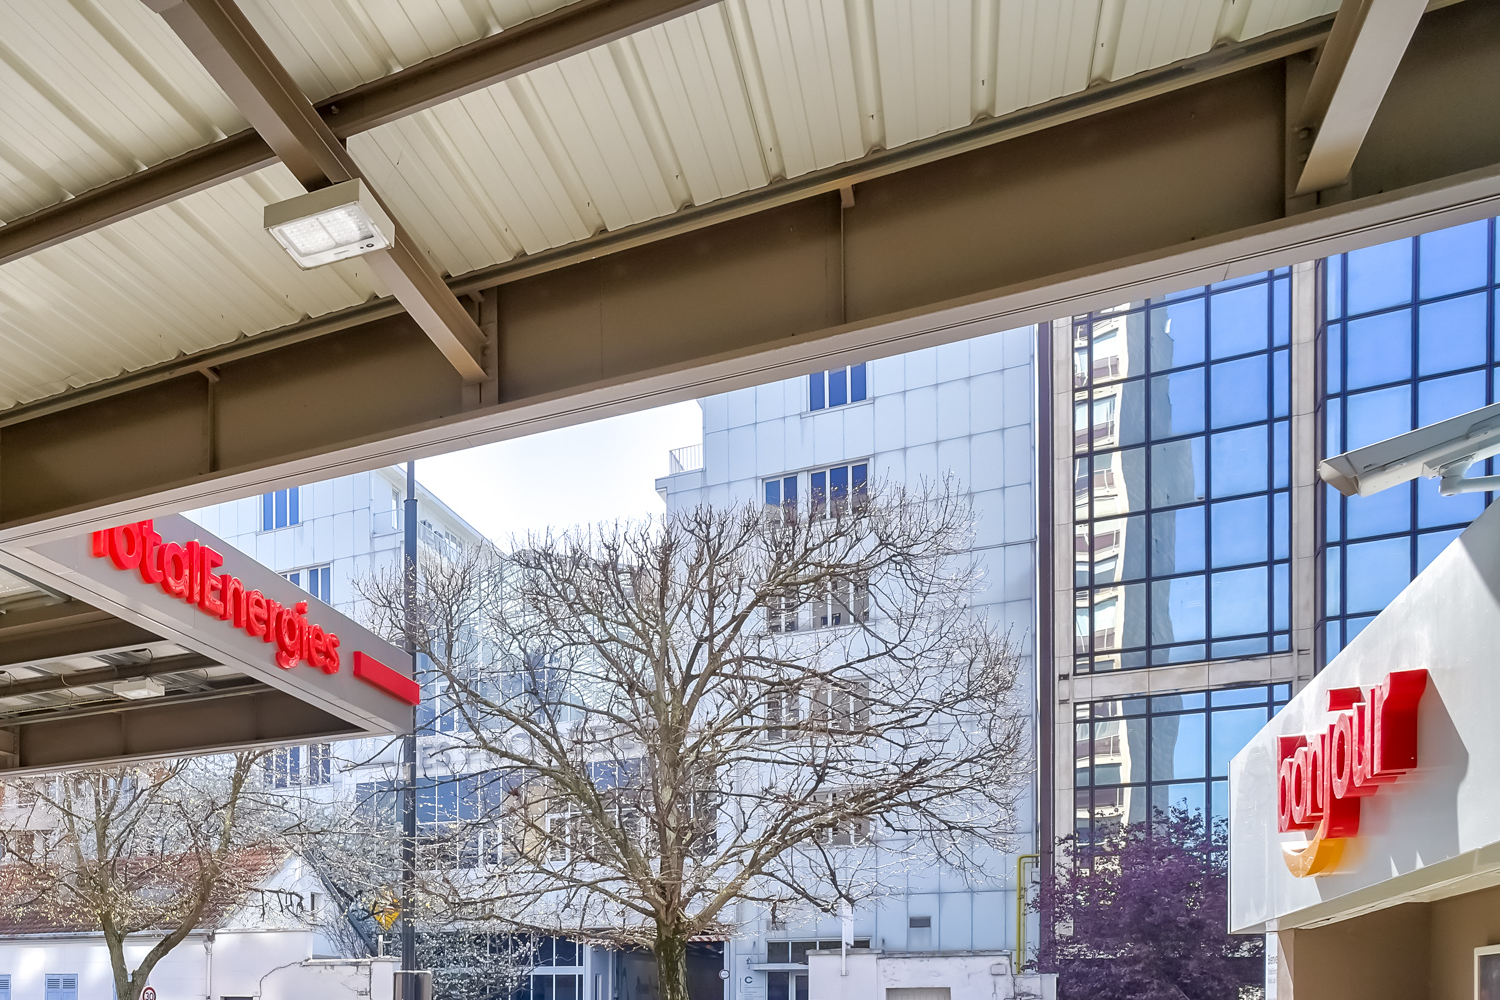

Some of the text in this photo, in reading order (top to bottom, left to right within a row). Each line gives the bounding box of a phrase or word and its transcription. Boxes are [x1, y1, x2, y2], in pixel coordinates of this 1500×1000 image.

[1277, 669, 1428, 878] bonjour
[744, 976, 753, 984] C
[145, 992, 154, 1000] 30
